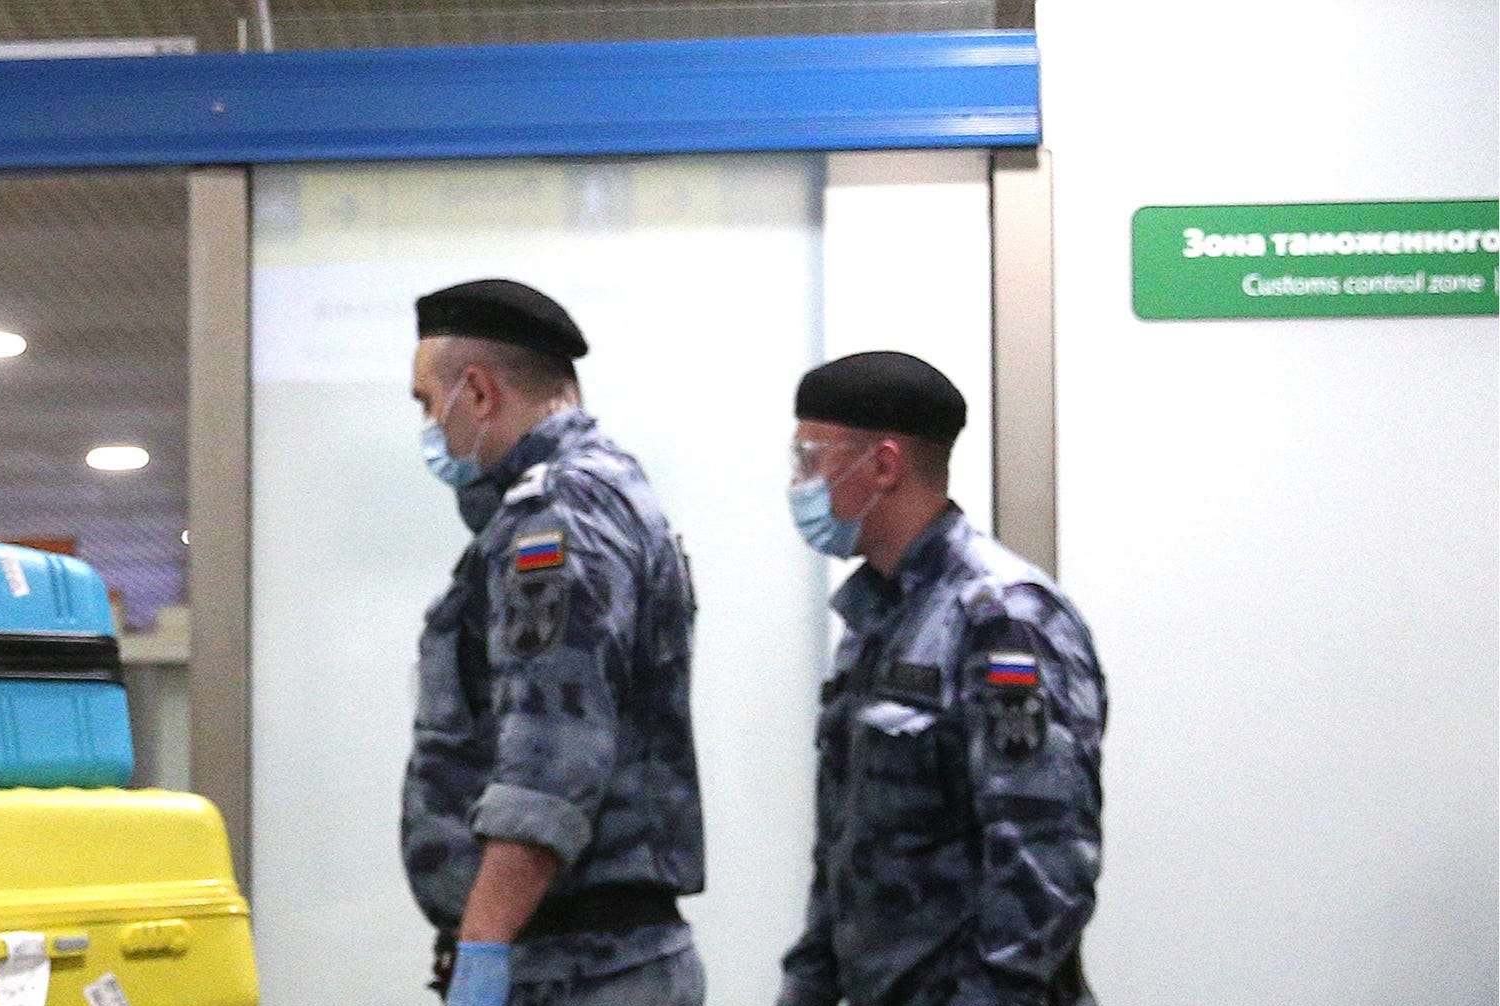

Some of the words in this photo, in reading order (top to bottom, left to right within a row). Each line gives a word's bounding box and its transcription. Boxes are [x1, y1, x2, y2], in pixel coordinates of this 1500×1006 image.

[1182, 228, 1266, 257] Зона
[1269, 229, 1499, 256] таможенного
[1242, 273, 1341, 297] Customs
[1343, 270, 1426, 295] control
[1428, 275, 1485, 293] zone
